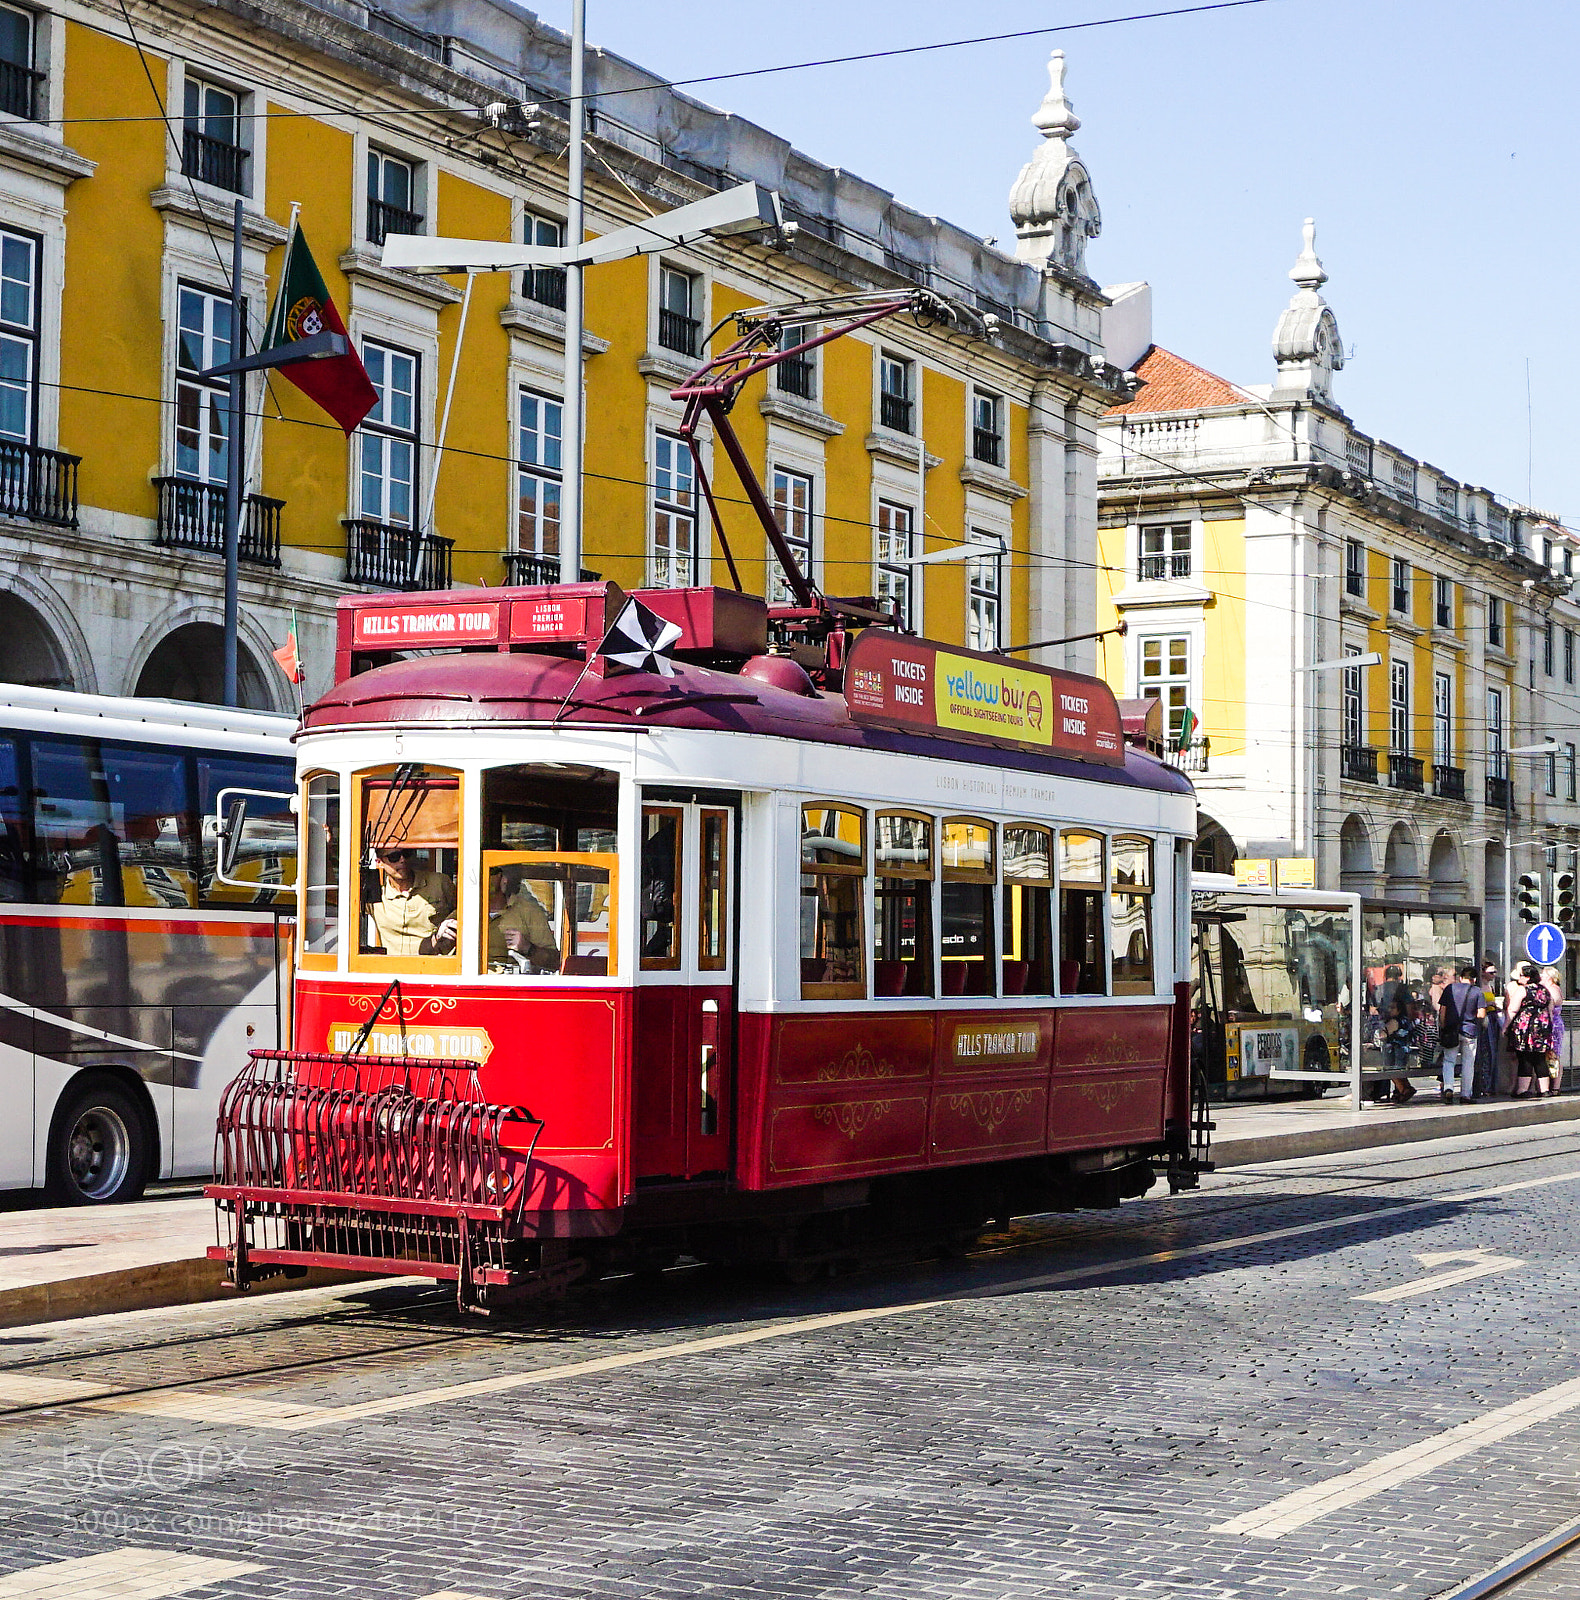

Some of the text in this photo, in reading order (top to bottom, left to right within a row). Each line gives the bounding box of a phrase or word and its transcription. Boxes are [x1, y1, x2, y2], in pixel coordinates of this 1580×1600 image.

[532, 613, 564, 623] PREMIUM
[535, 603, 561, 613] LISBON
[363, 612, 491, 634] HILLS TRAMCAR TOUR
[532, 623, 564, 632] TRAMCAR
[891, 658, 926, 682] TICKETS
[895, 684, 924, 706] INSIDE
[1060, 694, 1089, 714] TICKETS
[949, 703, 1024, 727] OFFICIAL SIGHTSEEING TOURS
[1063, 717, 1087, 736] INSIDE
[395, 734, 404, 755] 5
[936, 775, 959, 791] LISBON
[438, 1034, 483, 1057] TOUR
[957, 1032, 1037, 1056] HILLS TRAMCAR TOUR
